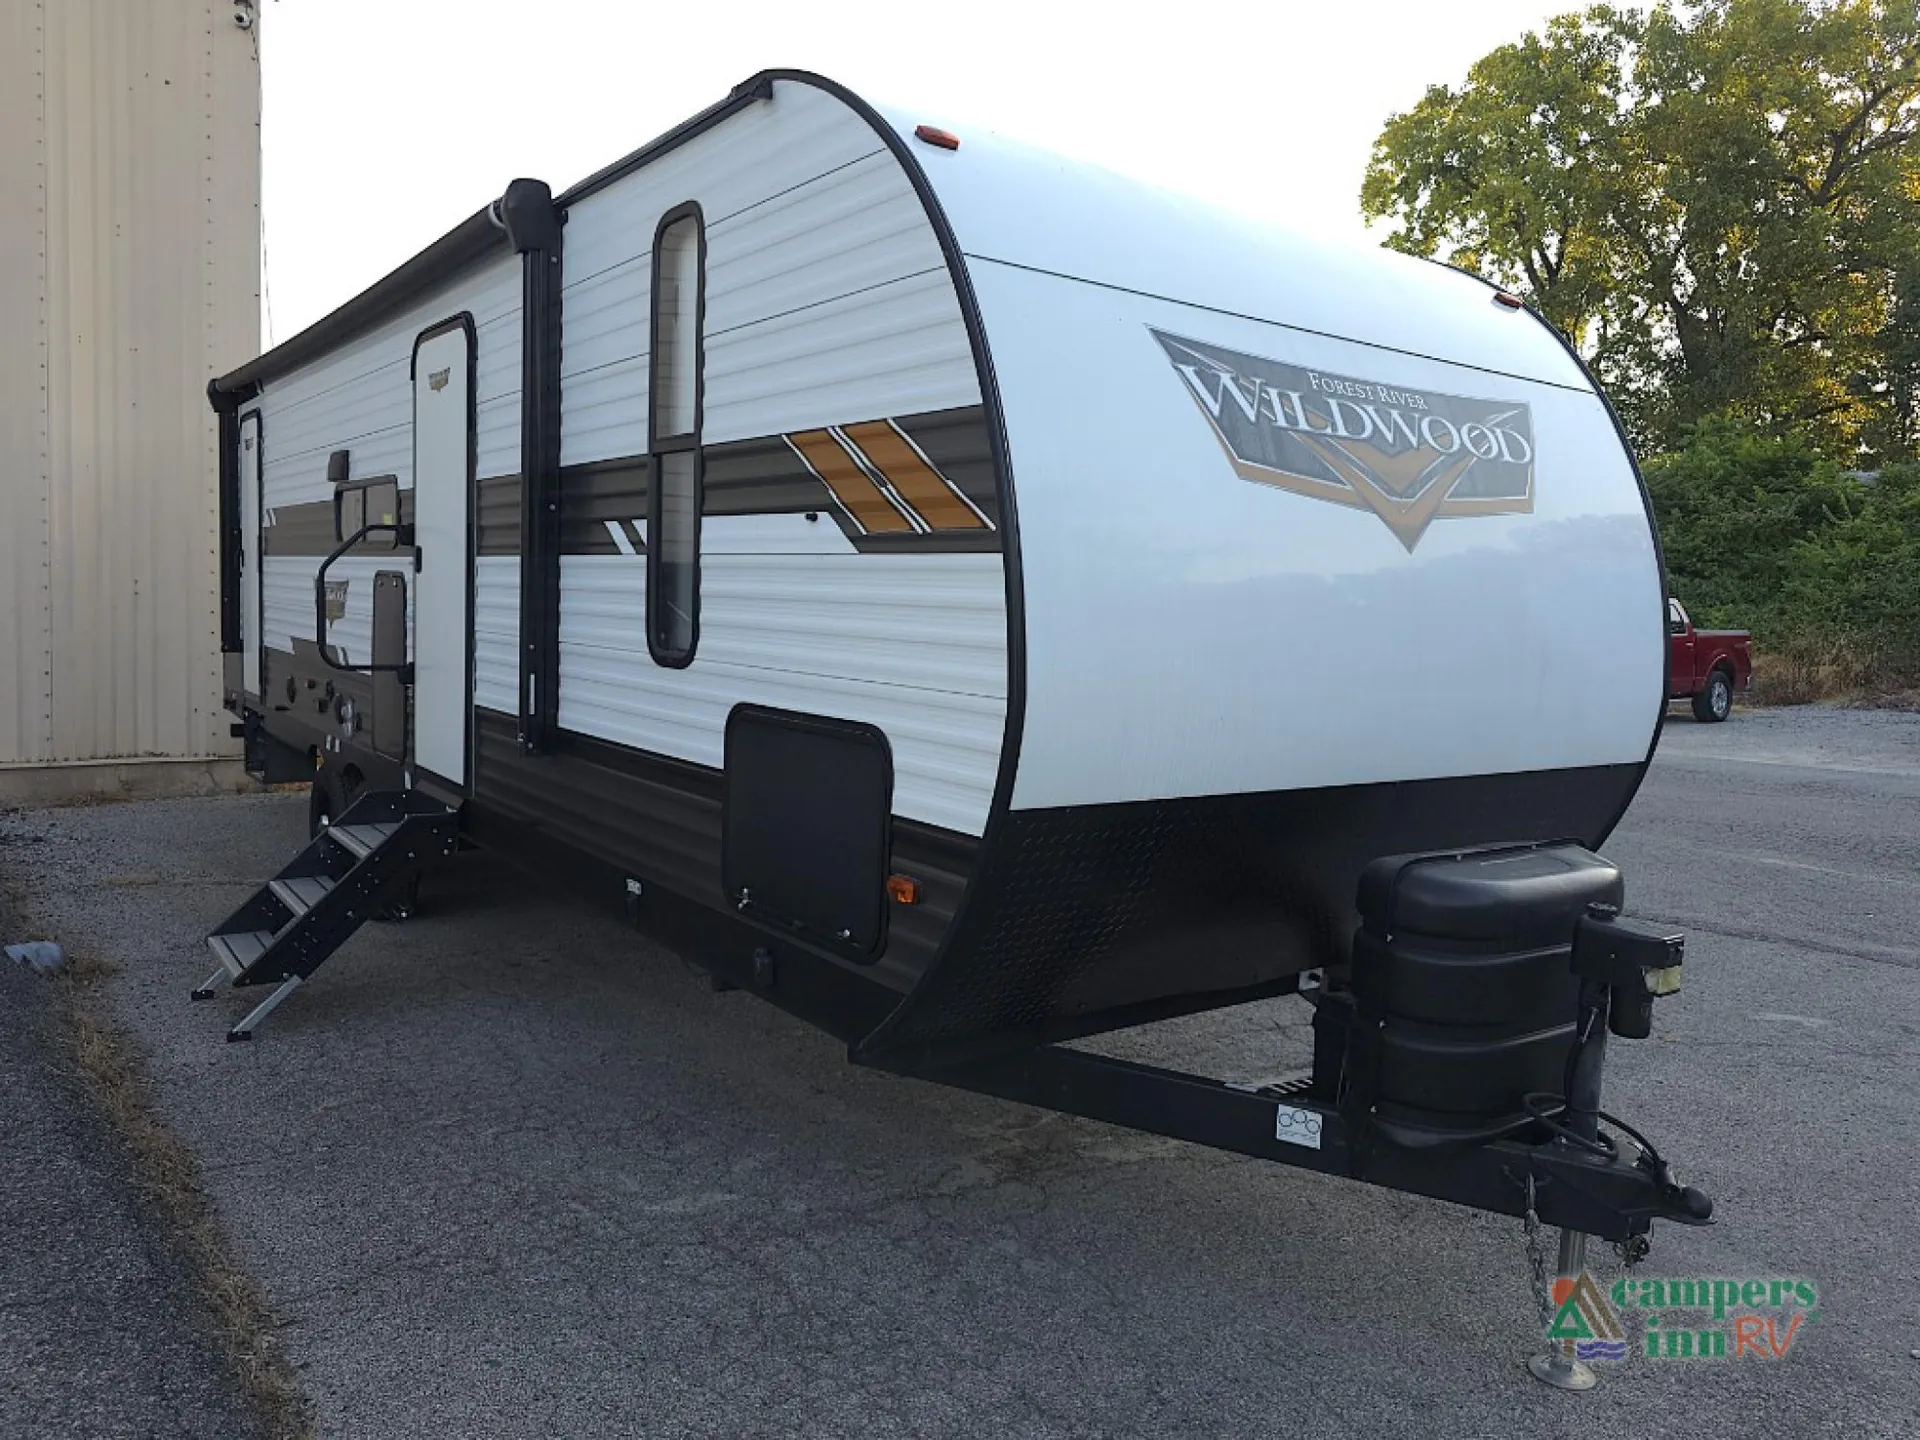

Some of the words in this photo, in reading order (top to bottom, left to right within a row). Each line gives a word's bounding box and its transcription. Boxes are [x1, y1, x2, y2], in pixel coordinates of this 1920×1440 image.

[1172, 363, 1532, 464] WILDWOOD
[1306, 371, 1375, 400] FOREST
[1377, 386, 1428, 410] RIVER
